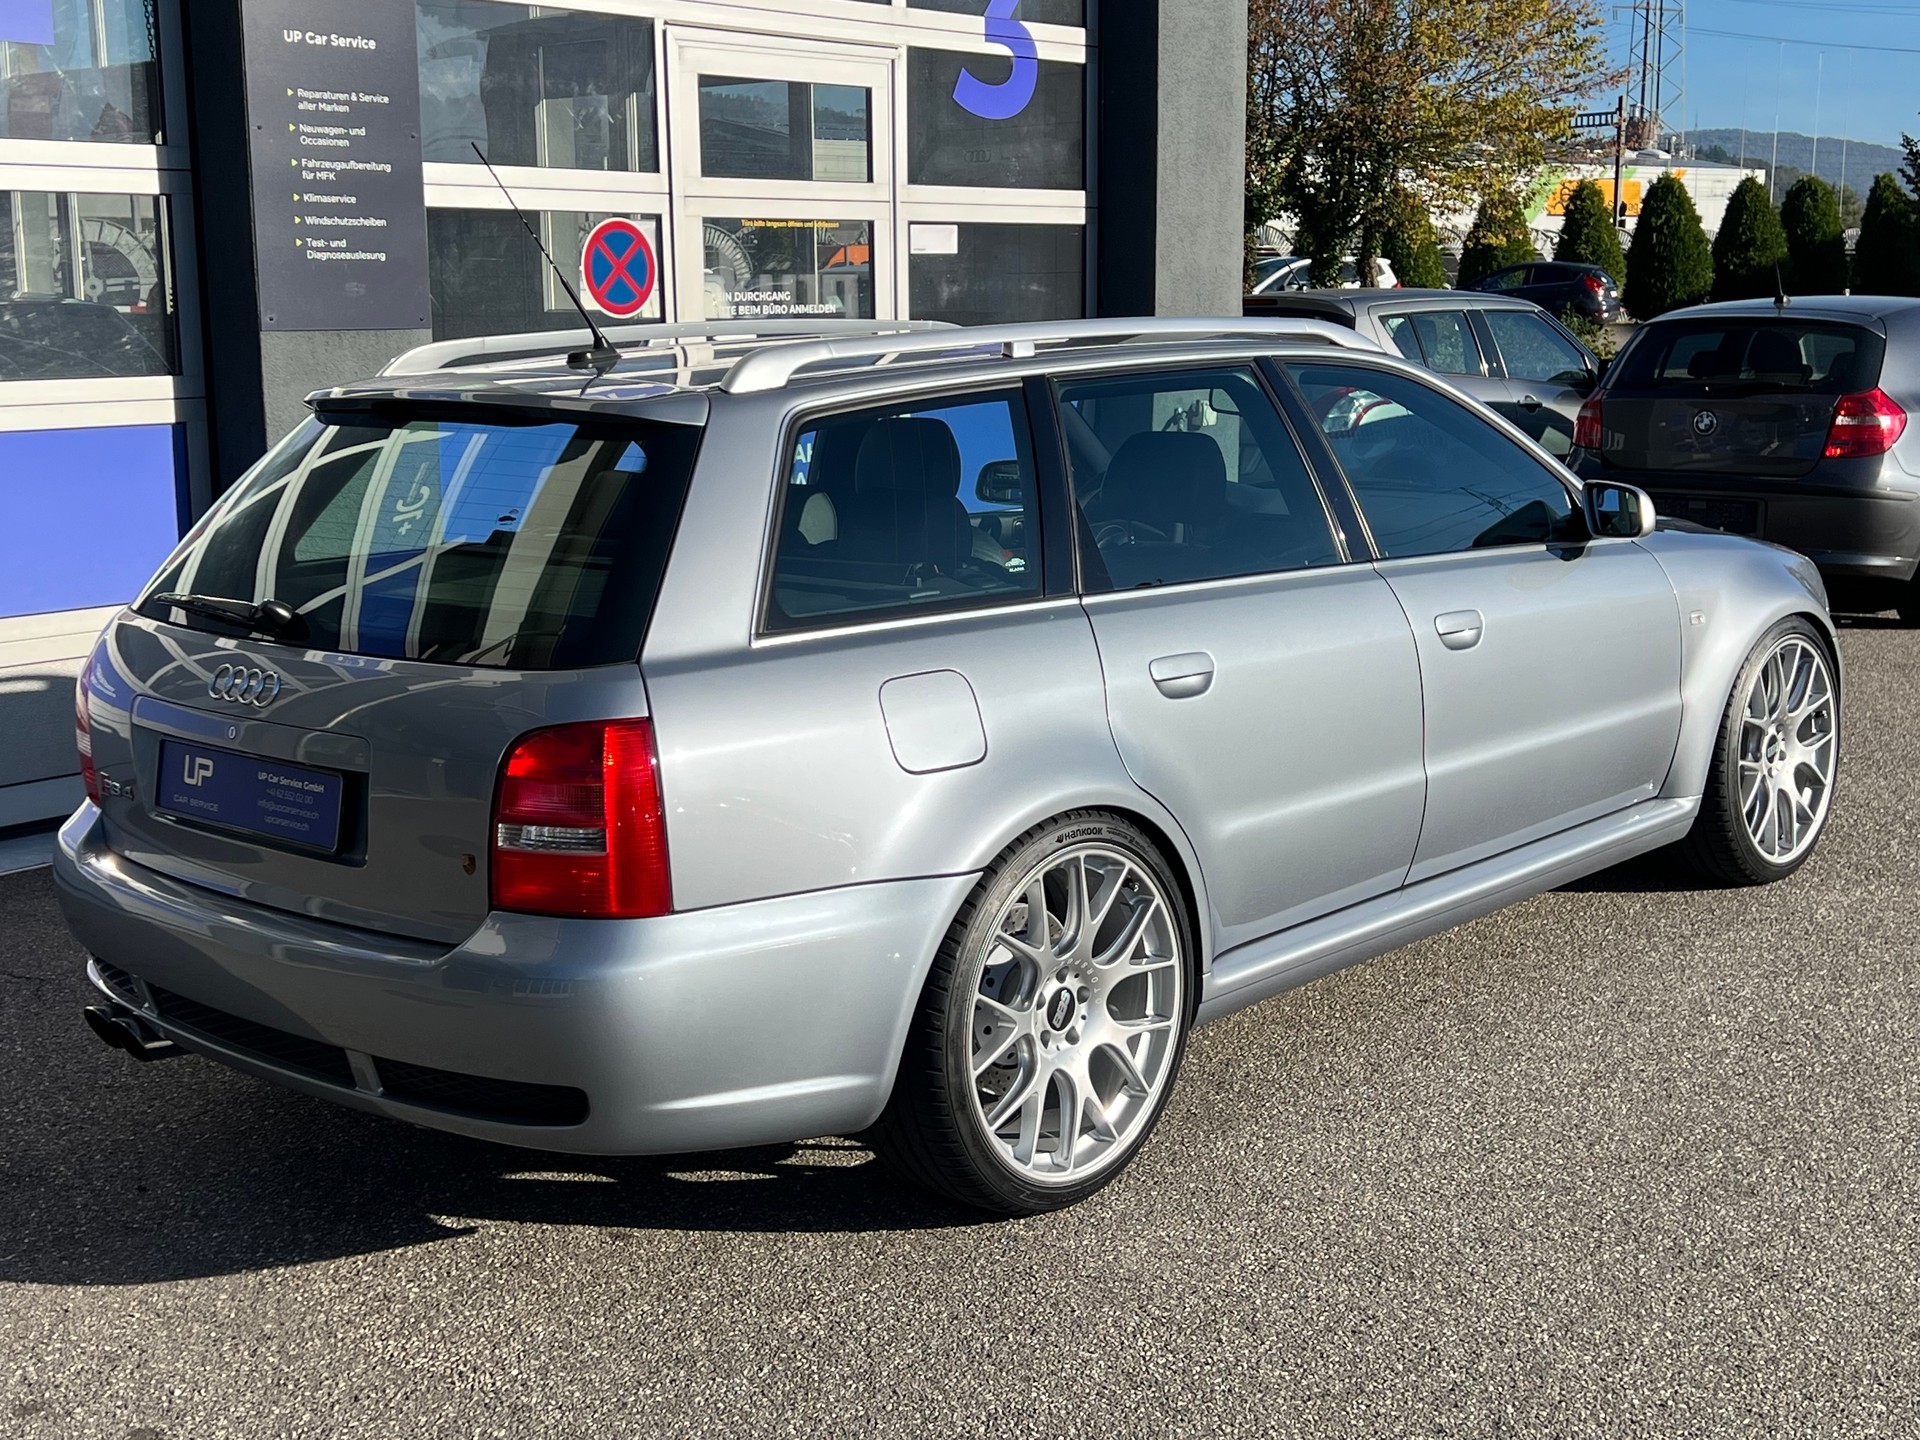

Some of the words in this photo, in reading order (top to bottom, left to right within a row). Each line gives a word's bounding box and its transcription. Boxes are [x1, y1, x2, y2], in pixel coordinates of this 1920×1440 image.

[283, 29, 303, 43] UP
[305, 31, 328, 46] Car
[330, 34, 377, 50] Service
[297, 88, 350, 101] Reparaturen
[350, 92, 358, 102] &
[358, 92, 390, 104] Service
[298, 101, 317, 111] aller
[318, 102, 350, 113] Marken
[299, 123, 348, 136] Neuwagen-
[348, 126, 366, 136] und
[300, 135, 350, 147] Occasionen
[301, 158, 392, 173] Fahrzeugaufbereitung
[302, 169, 315, 180] für
[315, 171, 337, 181] MFK
[303, 193, 357, 204] Klimaservice
[304, 215, 387, 227] Windschutzscheiben
[305, 238, 329, 247] Test-
[329, 239, 347, 248] und
[306, 250, 387, 262] Diagnoseauslesung
[733, 291, 791, 302] DURCHGANG
[738, 305, 761, 316] BEIM
[762, 302, 788, 315] BÜRO
[789, 304, 837, 315] ANMELDEN
[184, 754, 214, 787] UP
[257, 771, 268, 780] UP
[267, 773, 279, 783] Car
[279, 776, 303, 789] Service
[303, 781, 325, 793] GmbH
[173, 794, 189, 804] CAR
[190, 797, 219, 813] SERVICE
[1053, 989, 1071, 1029] BBS
